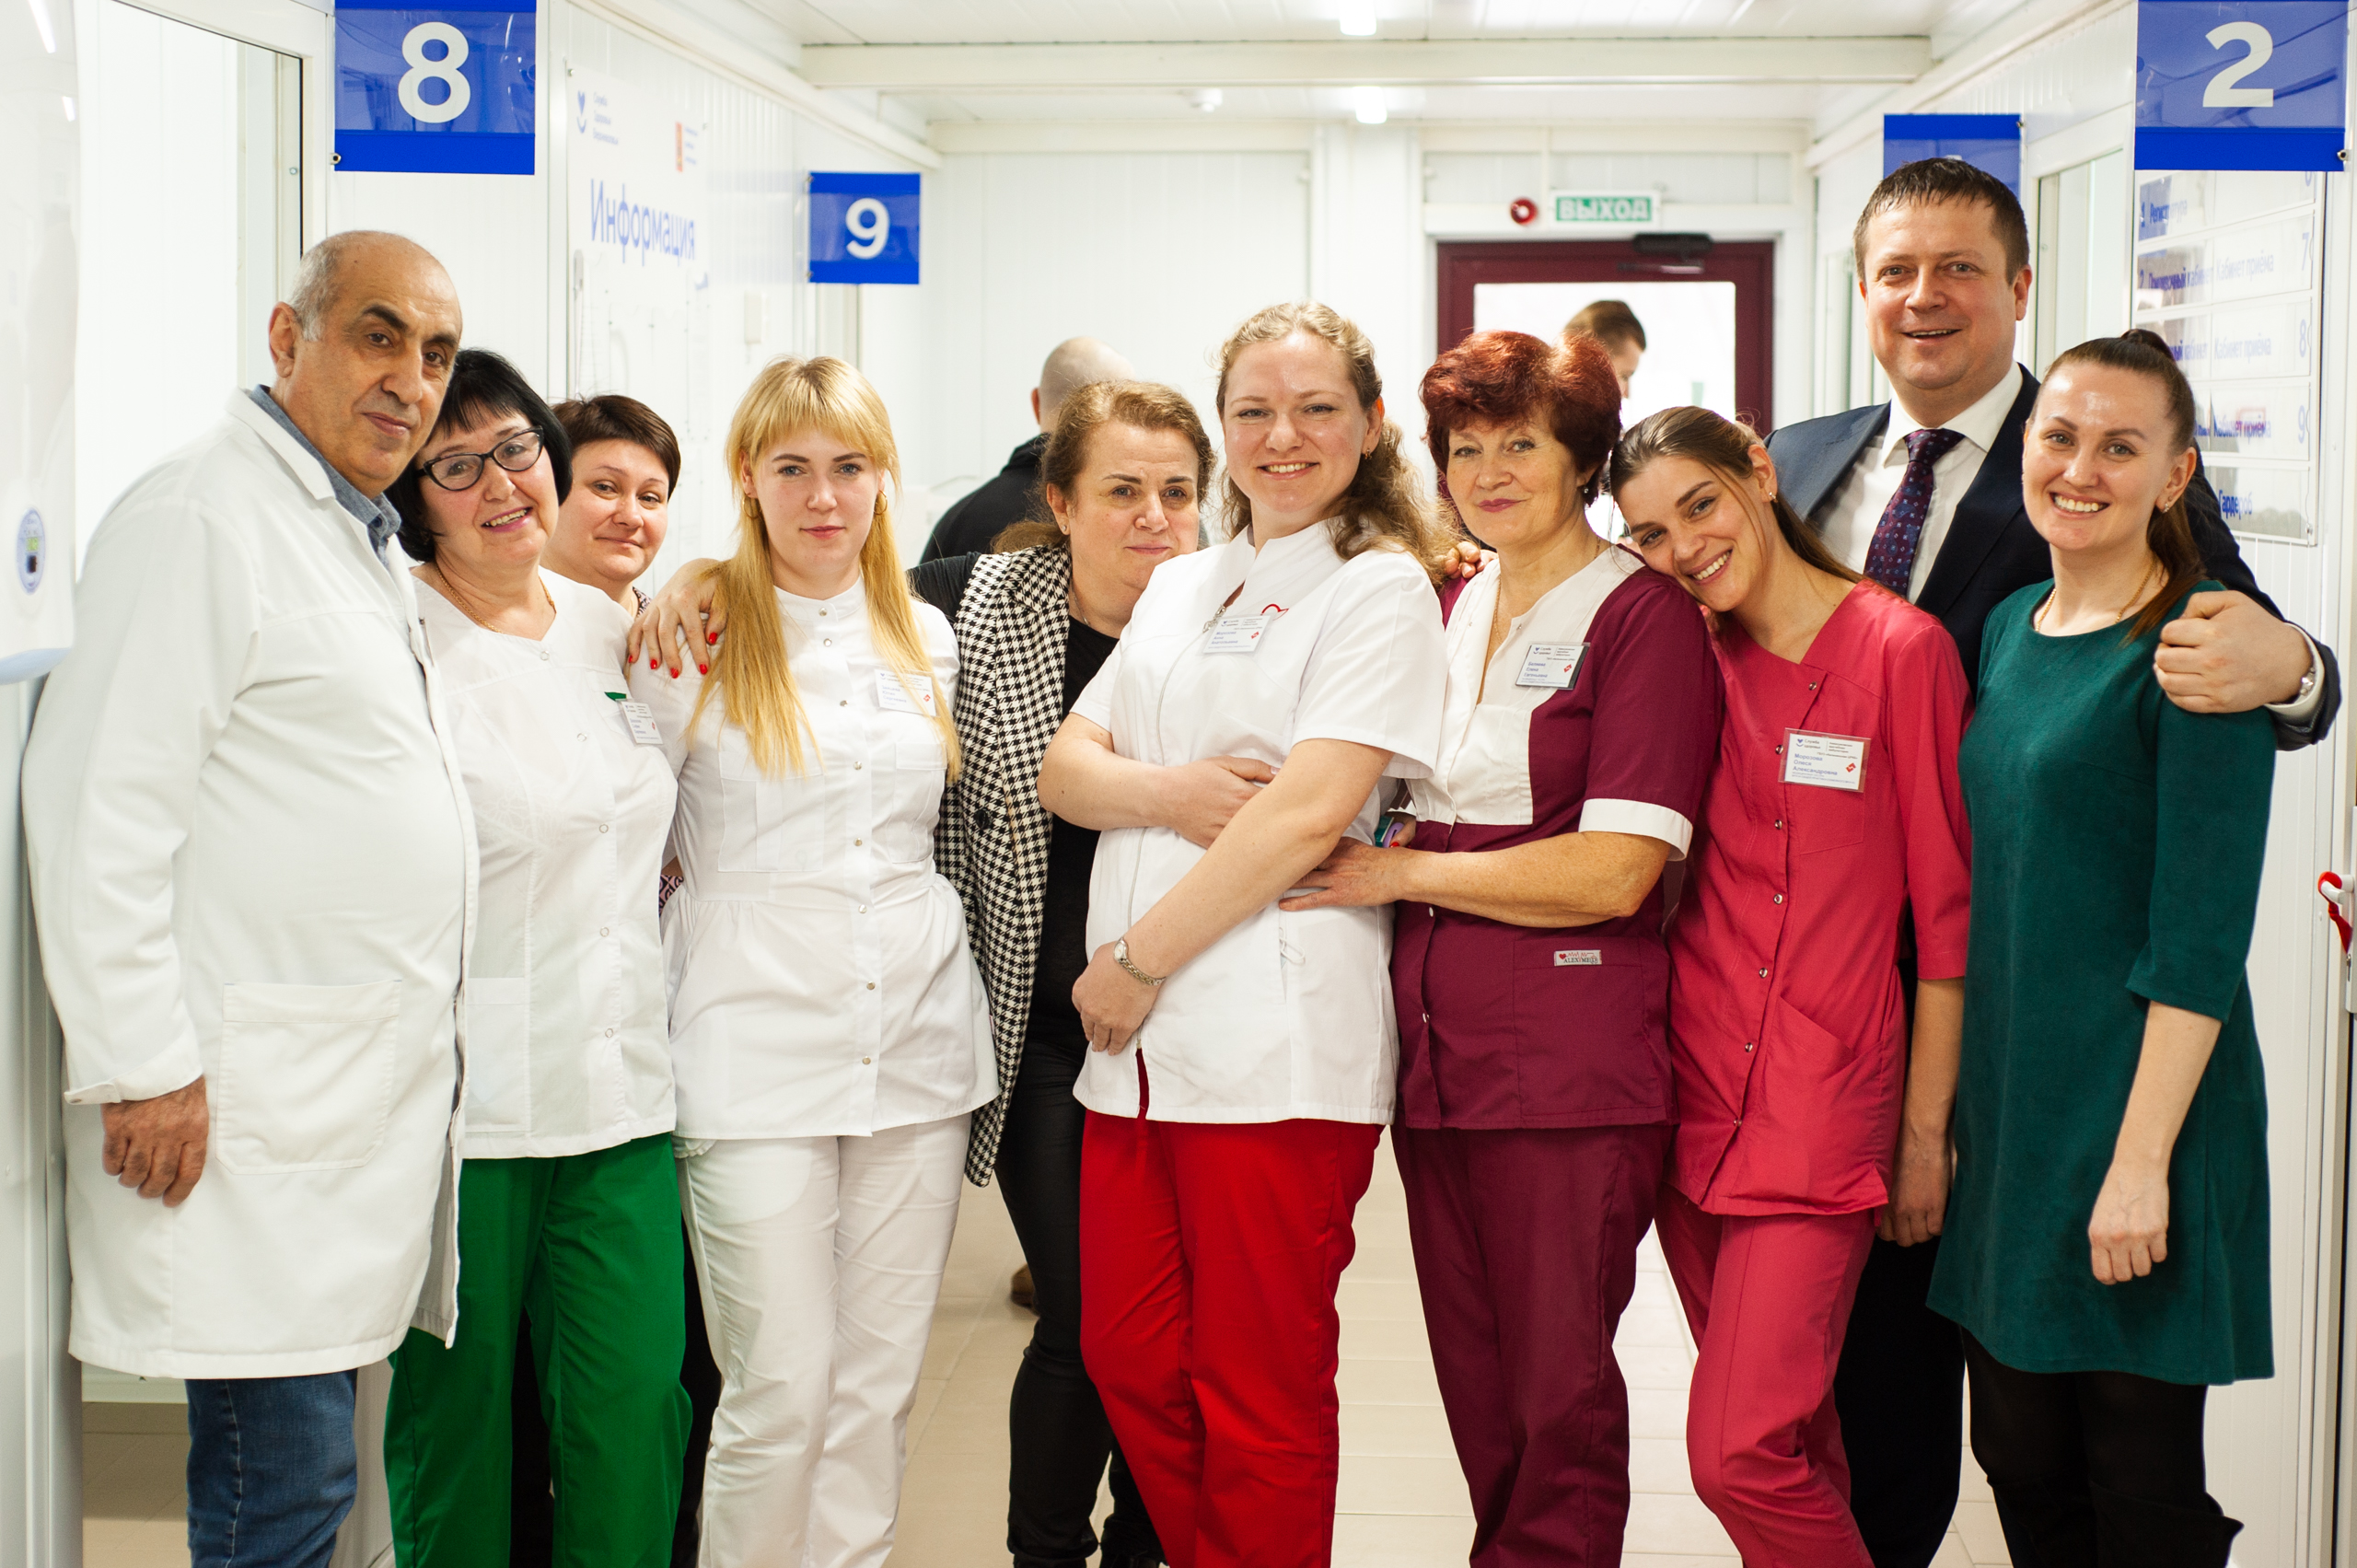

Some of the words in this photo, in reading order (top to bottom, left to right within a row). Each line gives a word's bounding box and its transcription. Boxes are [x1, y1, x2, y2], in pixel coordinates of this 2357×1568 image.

[397, 21, 471, 123] 8
[2202, 21, 2274, 108] 2
[590, 178, 696, 267] Информация
[845, 197, 889, 260] 9
[1559, 200, 1649, 221] ВЫХОД
[2216, 253, 2244, 282] Кабинет
[2302, 232, 2310, 271] 7
[2214, 335, 2243, 360] Кабинет
[2299, 319, 2307, 357] 8
[2213, 414, 2243, 438] Кабинет
[2298, 405, 2306, 443] 9
[2219, 489, 2253, 519] Гардероб
[1793, 766, 1838, 776] Александровна
[1794, 753, 1823, 761] Морозова
